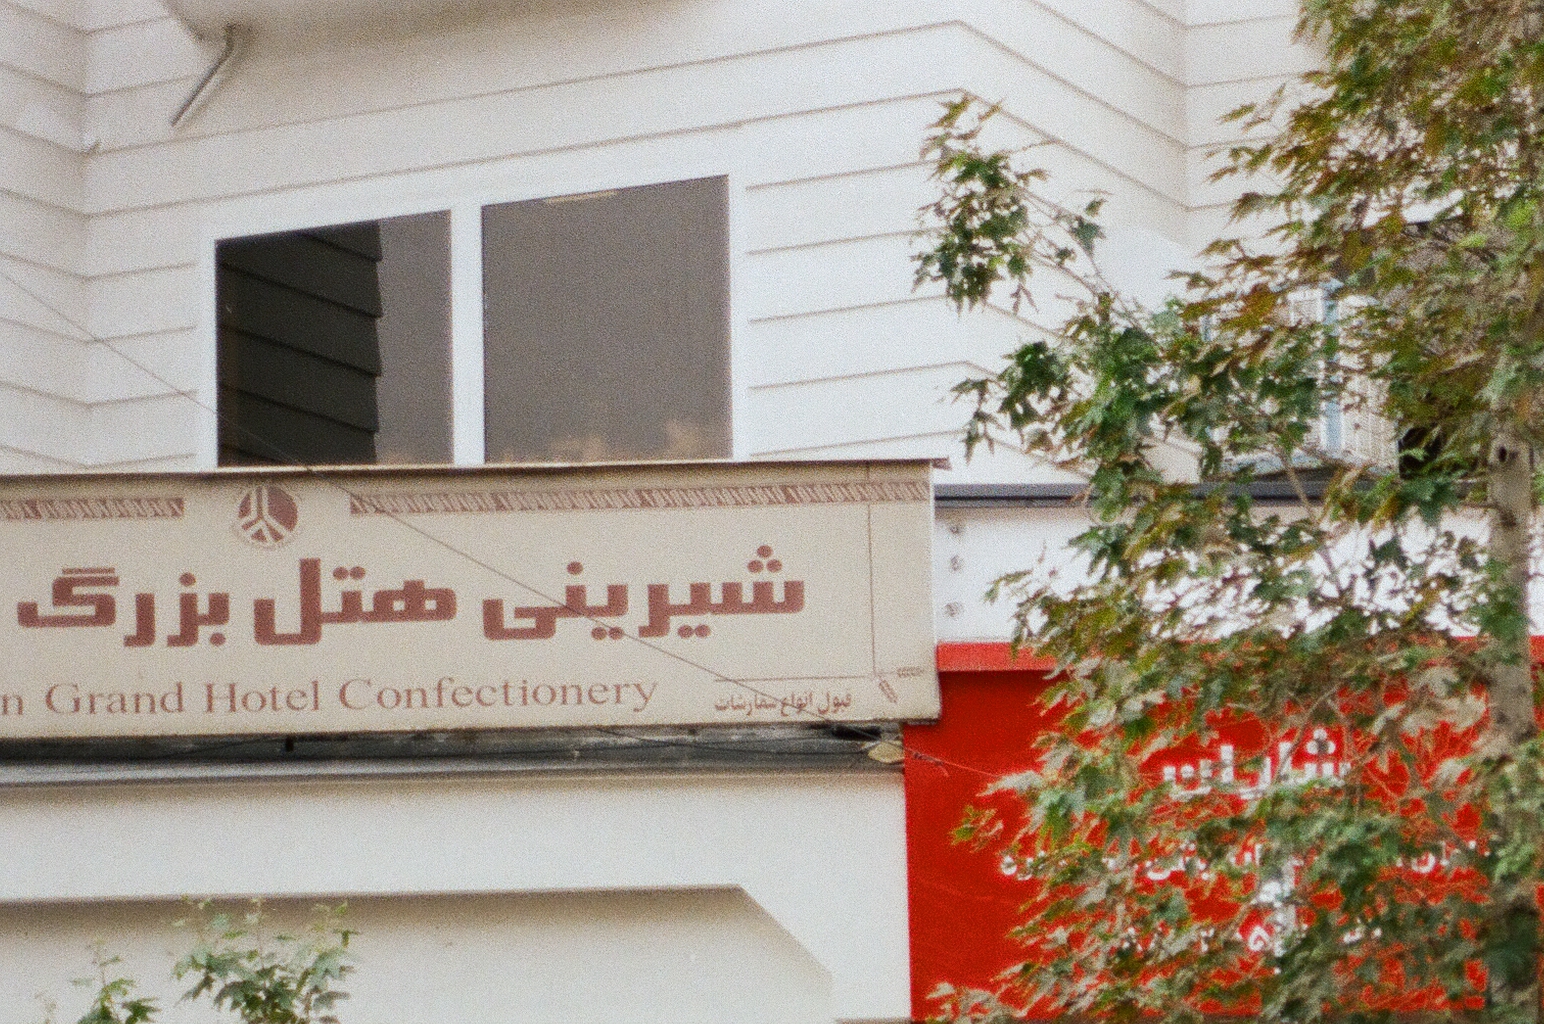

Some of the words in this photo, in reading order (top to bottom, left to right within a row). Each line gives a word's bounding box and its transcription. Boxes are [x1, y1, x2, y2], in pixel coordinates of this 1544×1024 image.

[17, 567, 231, 648] بزرگ
[253, 557, 458, 646] هتل
[482, 545, 805, 641] شیرینی
[44, 682, 185, 715] Grand
[205, 680, 321, 714] Hotel
[338, 676, 659, 713] Confectionery
[780, 691, 814, 717] انواع
[817, 691, 852, 715] قبول
